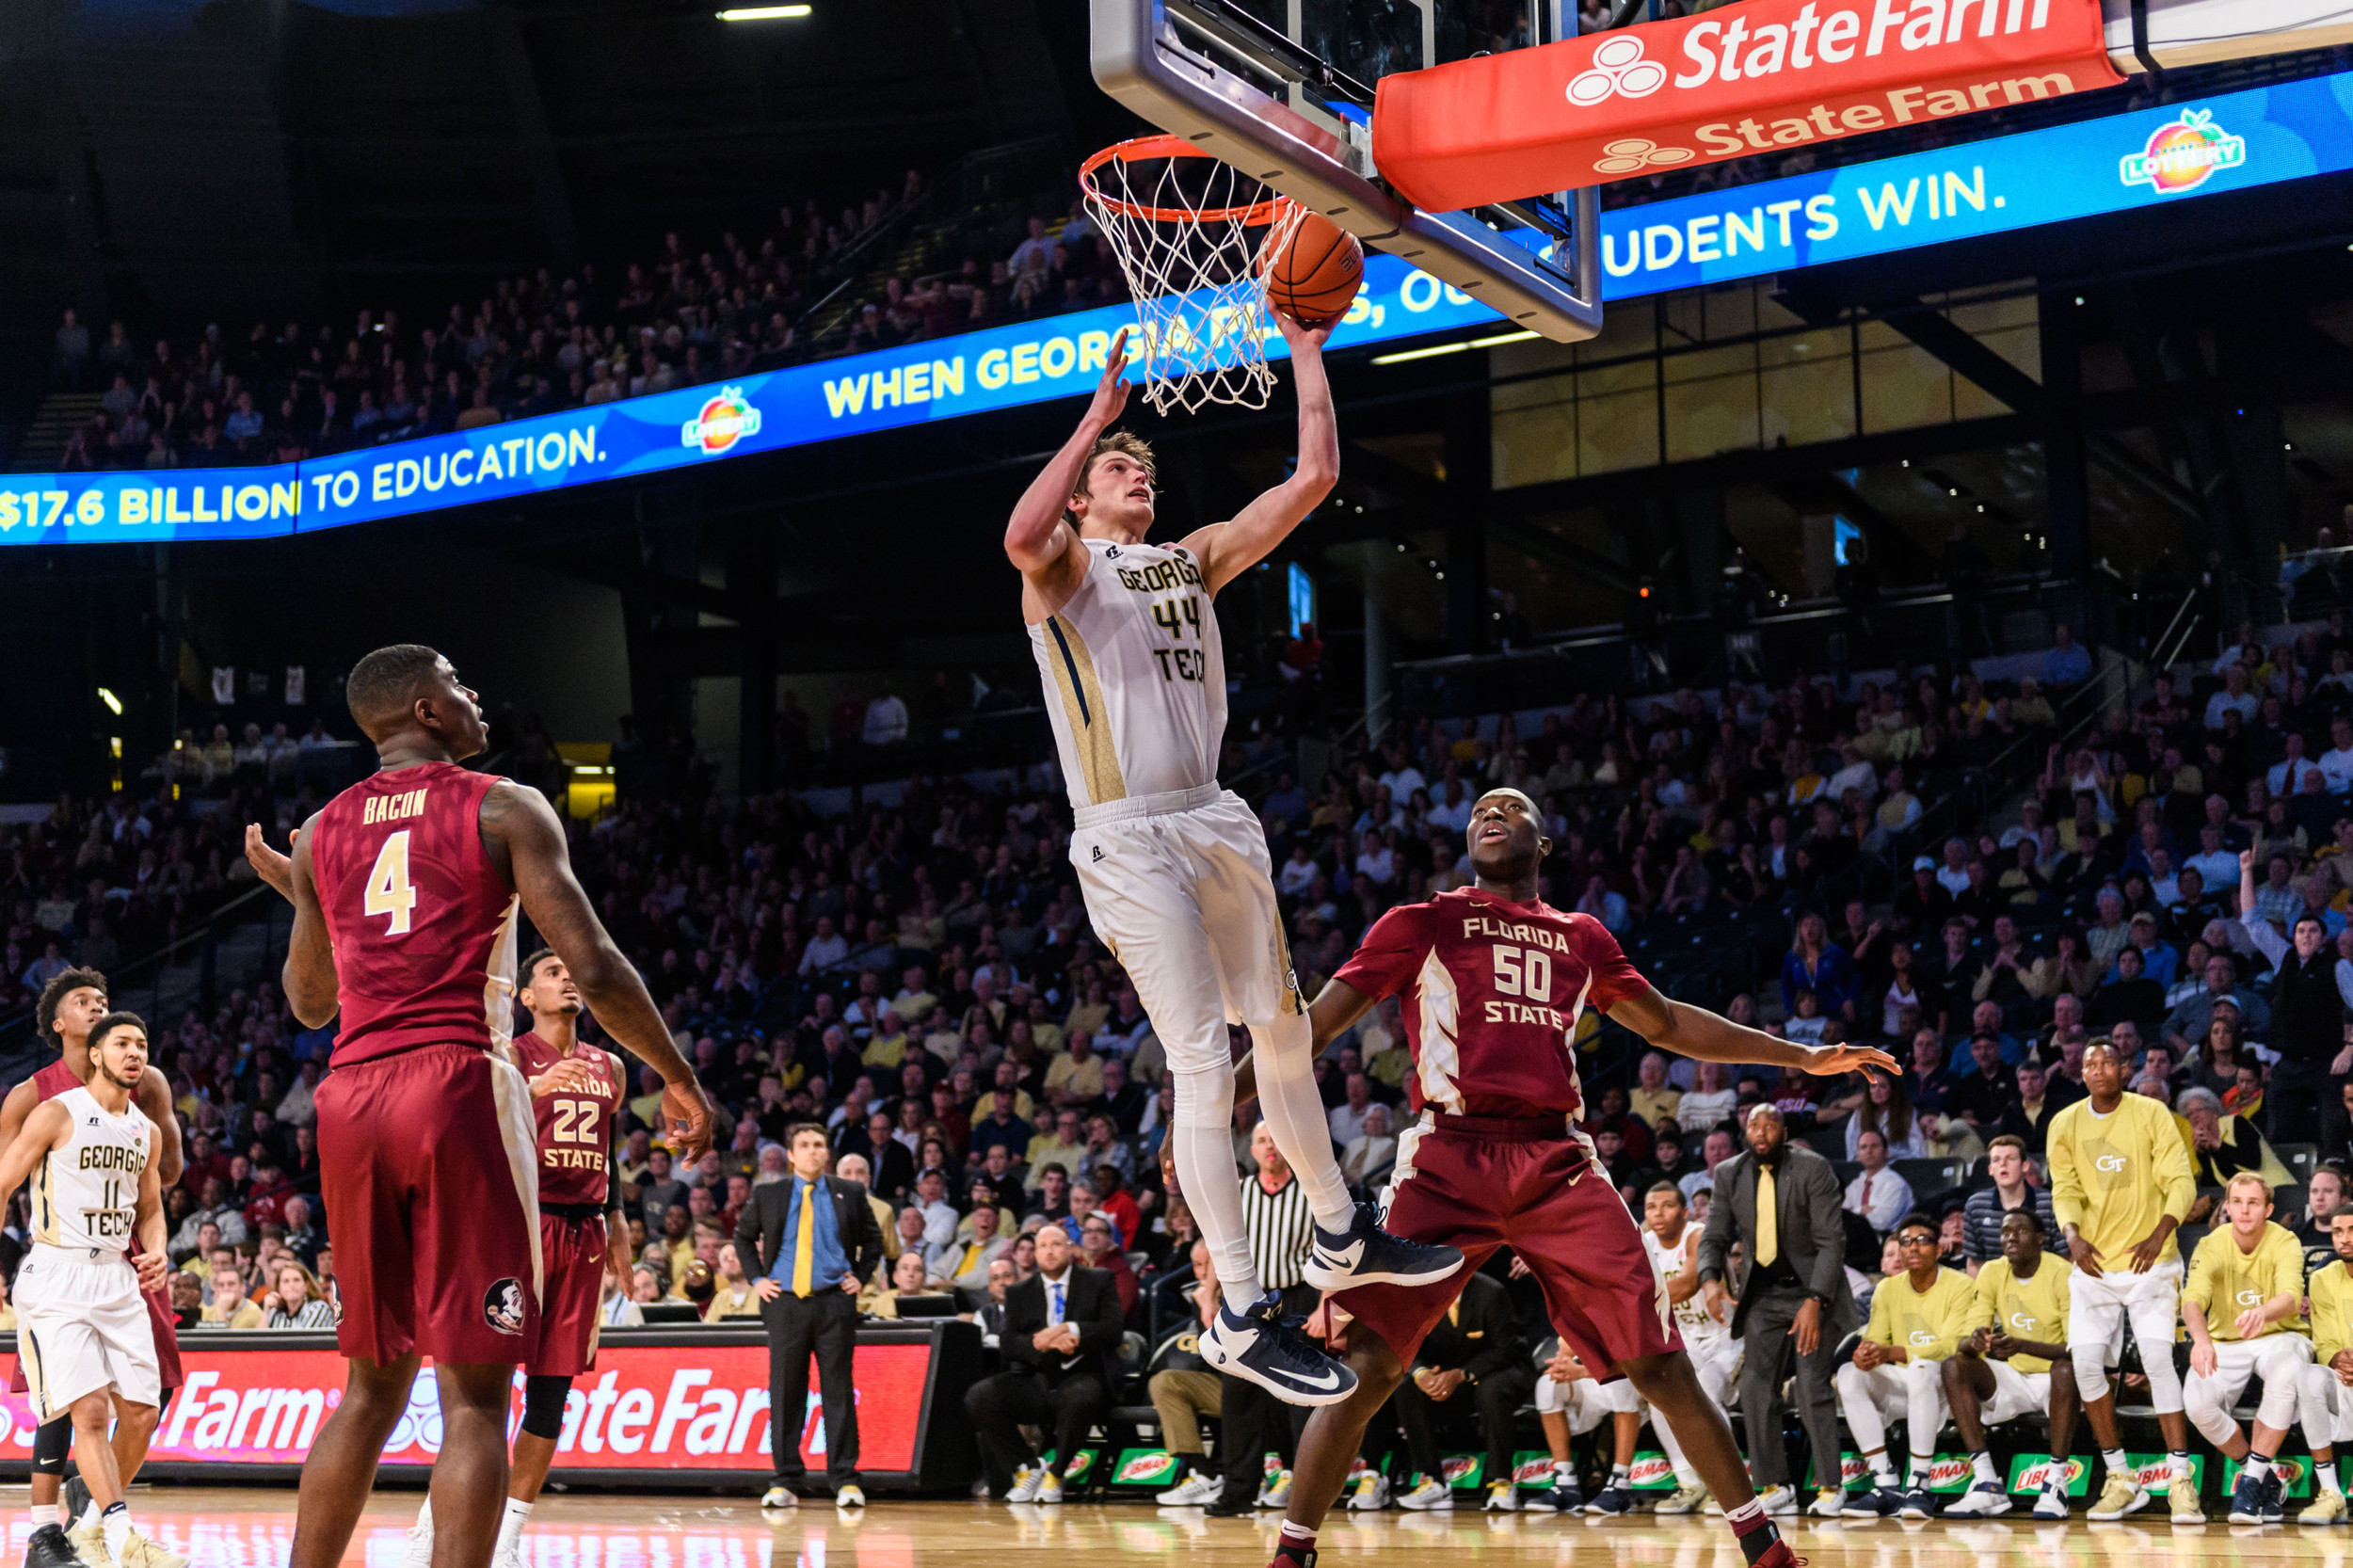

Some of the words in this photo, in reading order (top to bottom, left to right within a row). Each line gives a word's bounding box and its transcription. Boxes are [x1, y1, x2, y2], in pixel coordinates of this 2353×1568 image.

[823, 356, 964, 418] WHEN
[1540, 194, 1838, 277] UDENTS
[1858, 166, 2006, 230] WIN.
[0, 490, 104, 532] $17.6
[119, 479, 302, 525] BILLION
[312, 471, 360, 511] TO
[373, 425, 606, 502] EDUCATION.
[1152, 596, 1201, 640] 44
[1154, 648, 1205, 683] TEC
[363, 789, 428, 824] BACON
[364, 830, 416, 936] 4
[1463, 918, 1570, 954] FLORIDA
[1493, 944, 1551, 1002] 50
[1484, 1001, 1563, 1032] STATE
[553, 1099, 600, 1144] 22
[80, 1145, 146, 1175] GEORGIA
[544, 1149, 603, 1171] STATE
[2096, 1155, 2126, 1172] GT
[104, 1178, 120, 1209] 11
[84, 1213, 132, 1236] TECH
[2236, 1289, 2265, 1307] GT
[2011, 1312, 2036, 1331] GT
[1910, 1330, 1936, 1346] GT
[1629, 1461, 1673, 1480] IBMAN
[1930, 1462, 1971, 1480] BMAN
